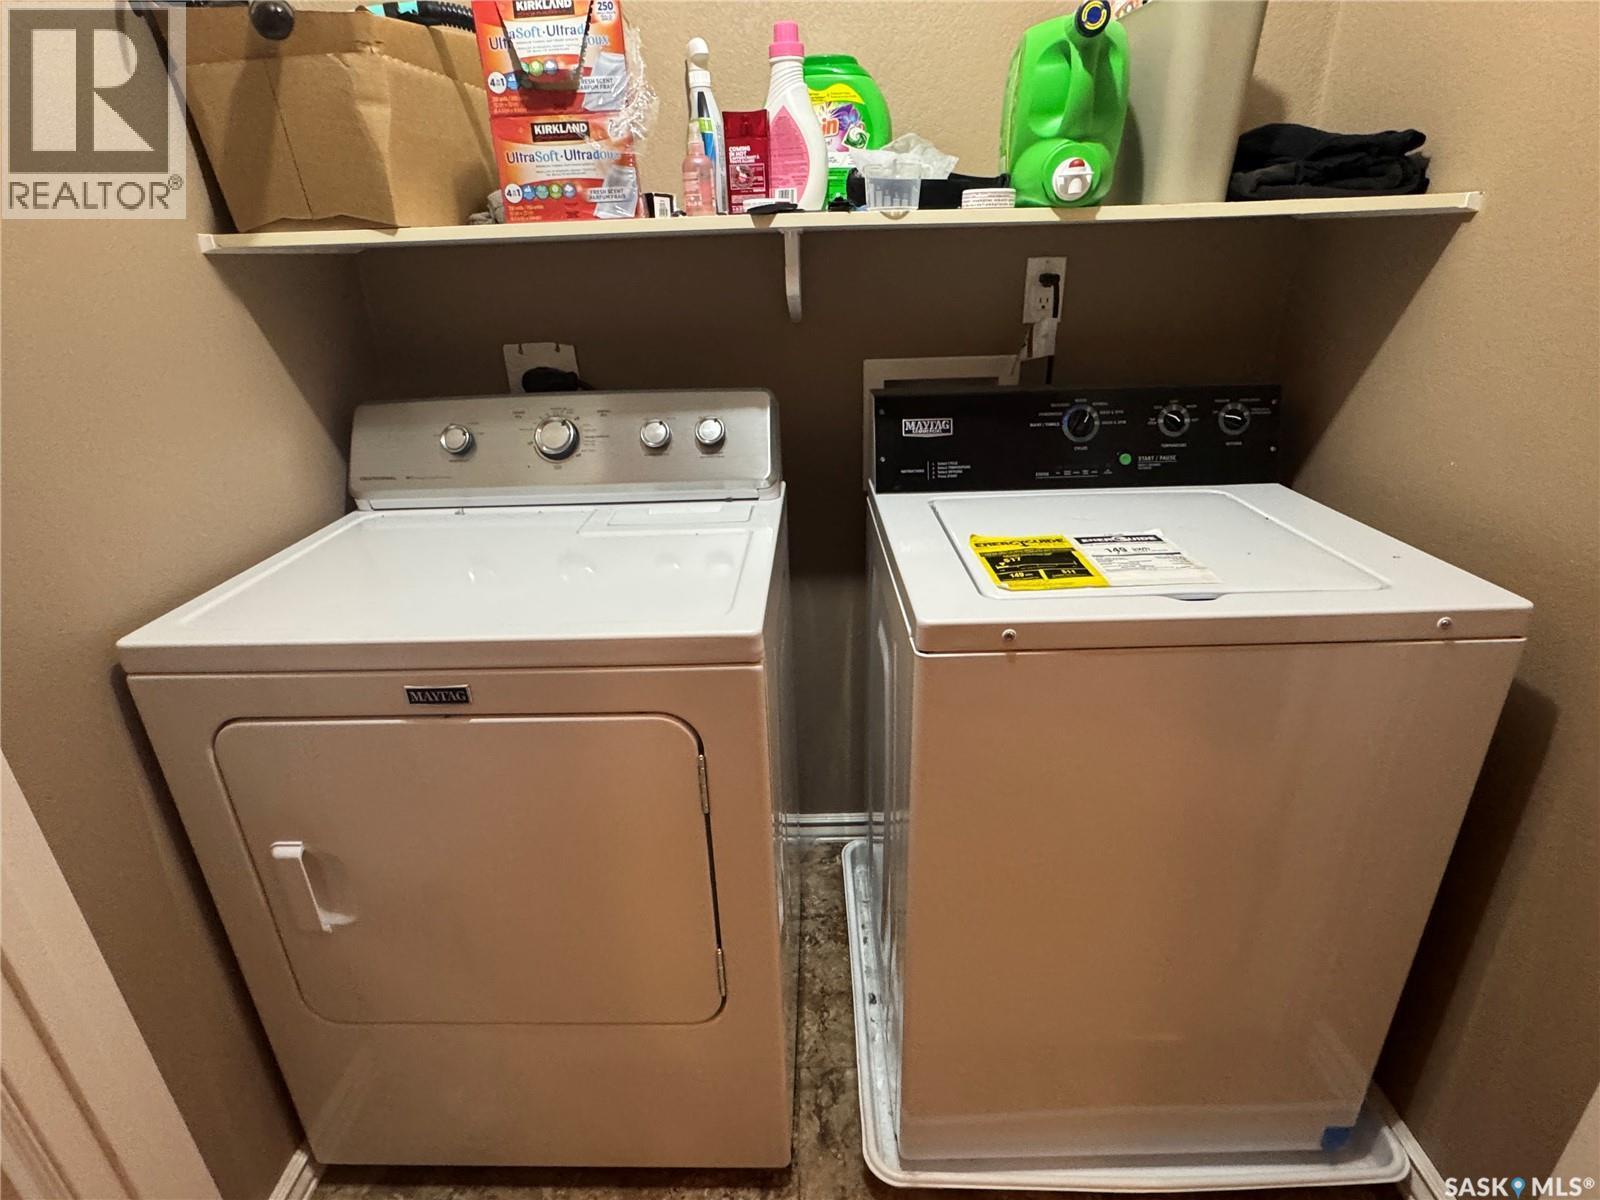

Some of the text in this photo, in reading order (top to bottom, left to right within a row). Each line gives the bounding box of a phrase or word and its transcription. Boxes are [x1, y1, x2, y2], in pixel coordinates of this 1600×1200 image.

[516, 0, 572, 11] KIRKLAND
[597, 1, 613, 11] 250
[534, 123, 588, 135] KIRKLAND
[905, 421, 950, 431] MAYTAG
[409, 690, 467, 702] MAYTAG
